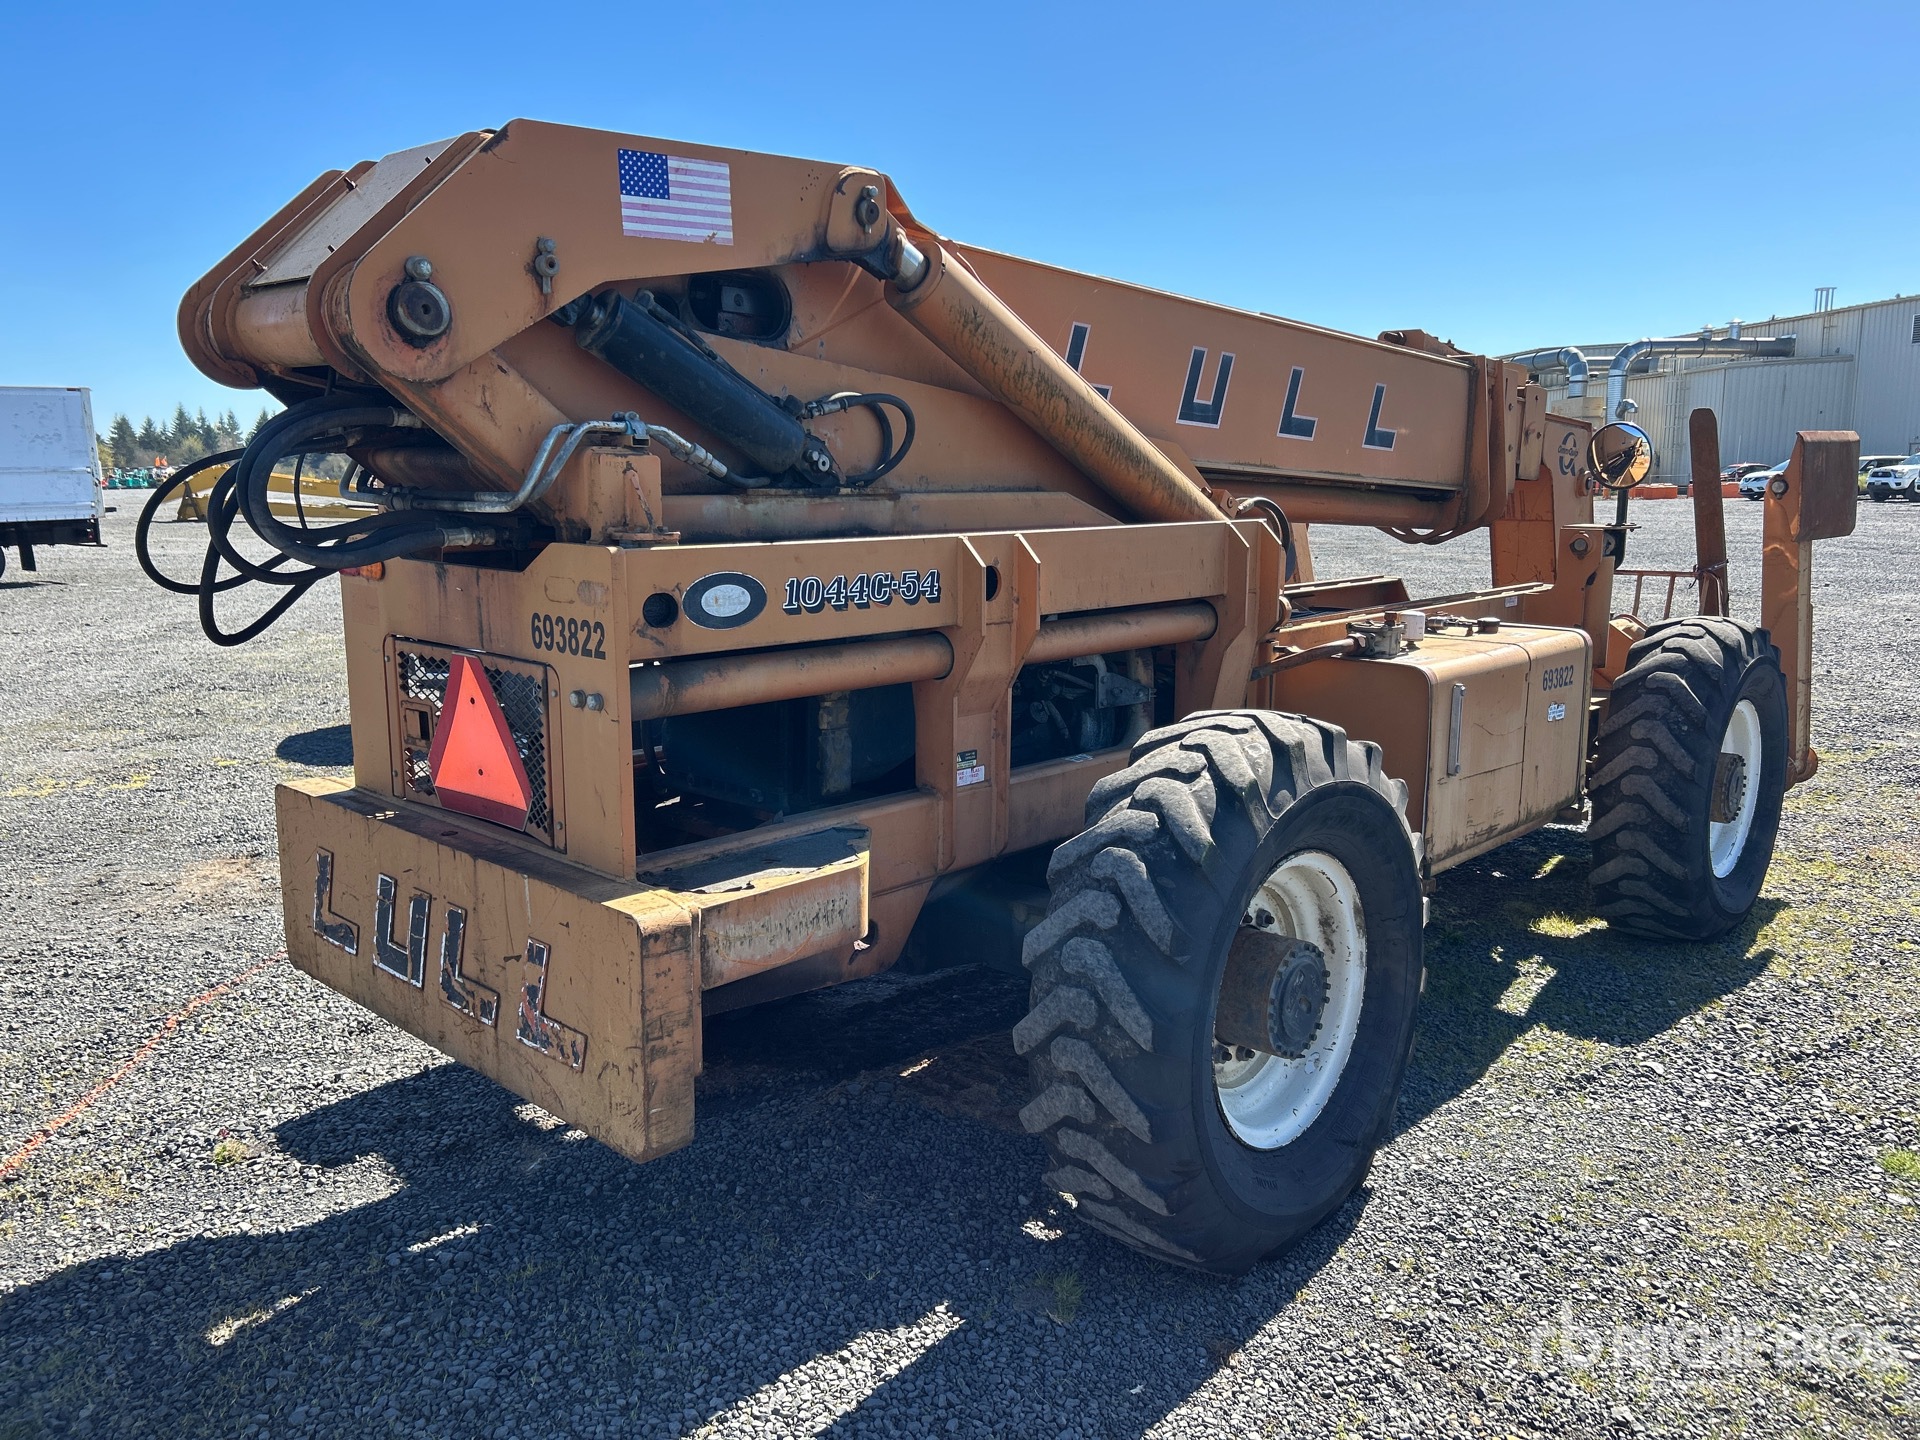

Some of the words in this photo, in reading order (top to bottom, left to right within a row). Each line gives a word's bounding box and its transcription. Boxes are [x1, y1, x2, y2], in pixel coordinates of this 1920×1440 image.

[531, 612, 606, 660] 693822
[1542, 664, 1574, 691] 693822
[312, 846, 588, 1073] LULL
